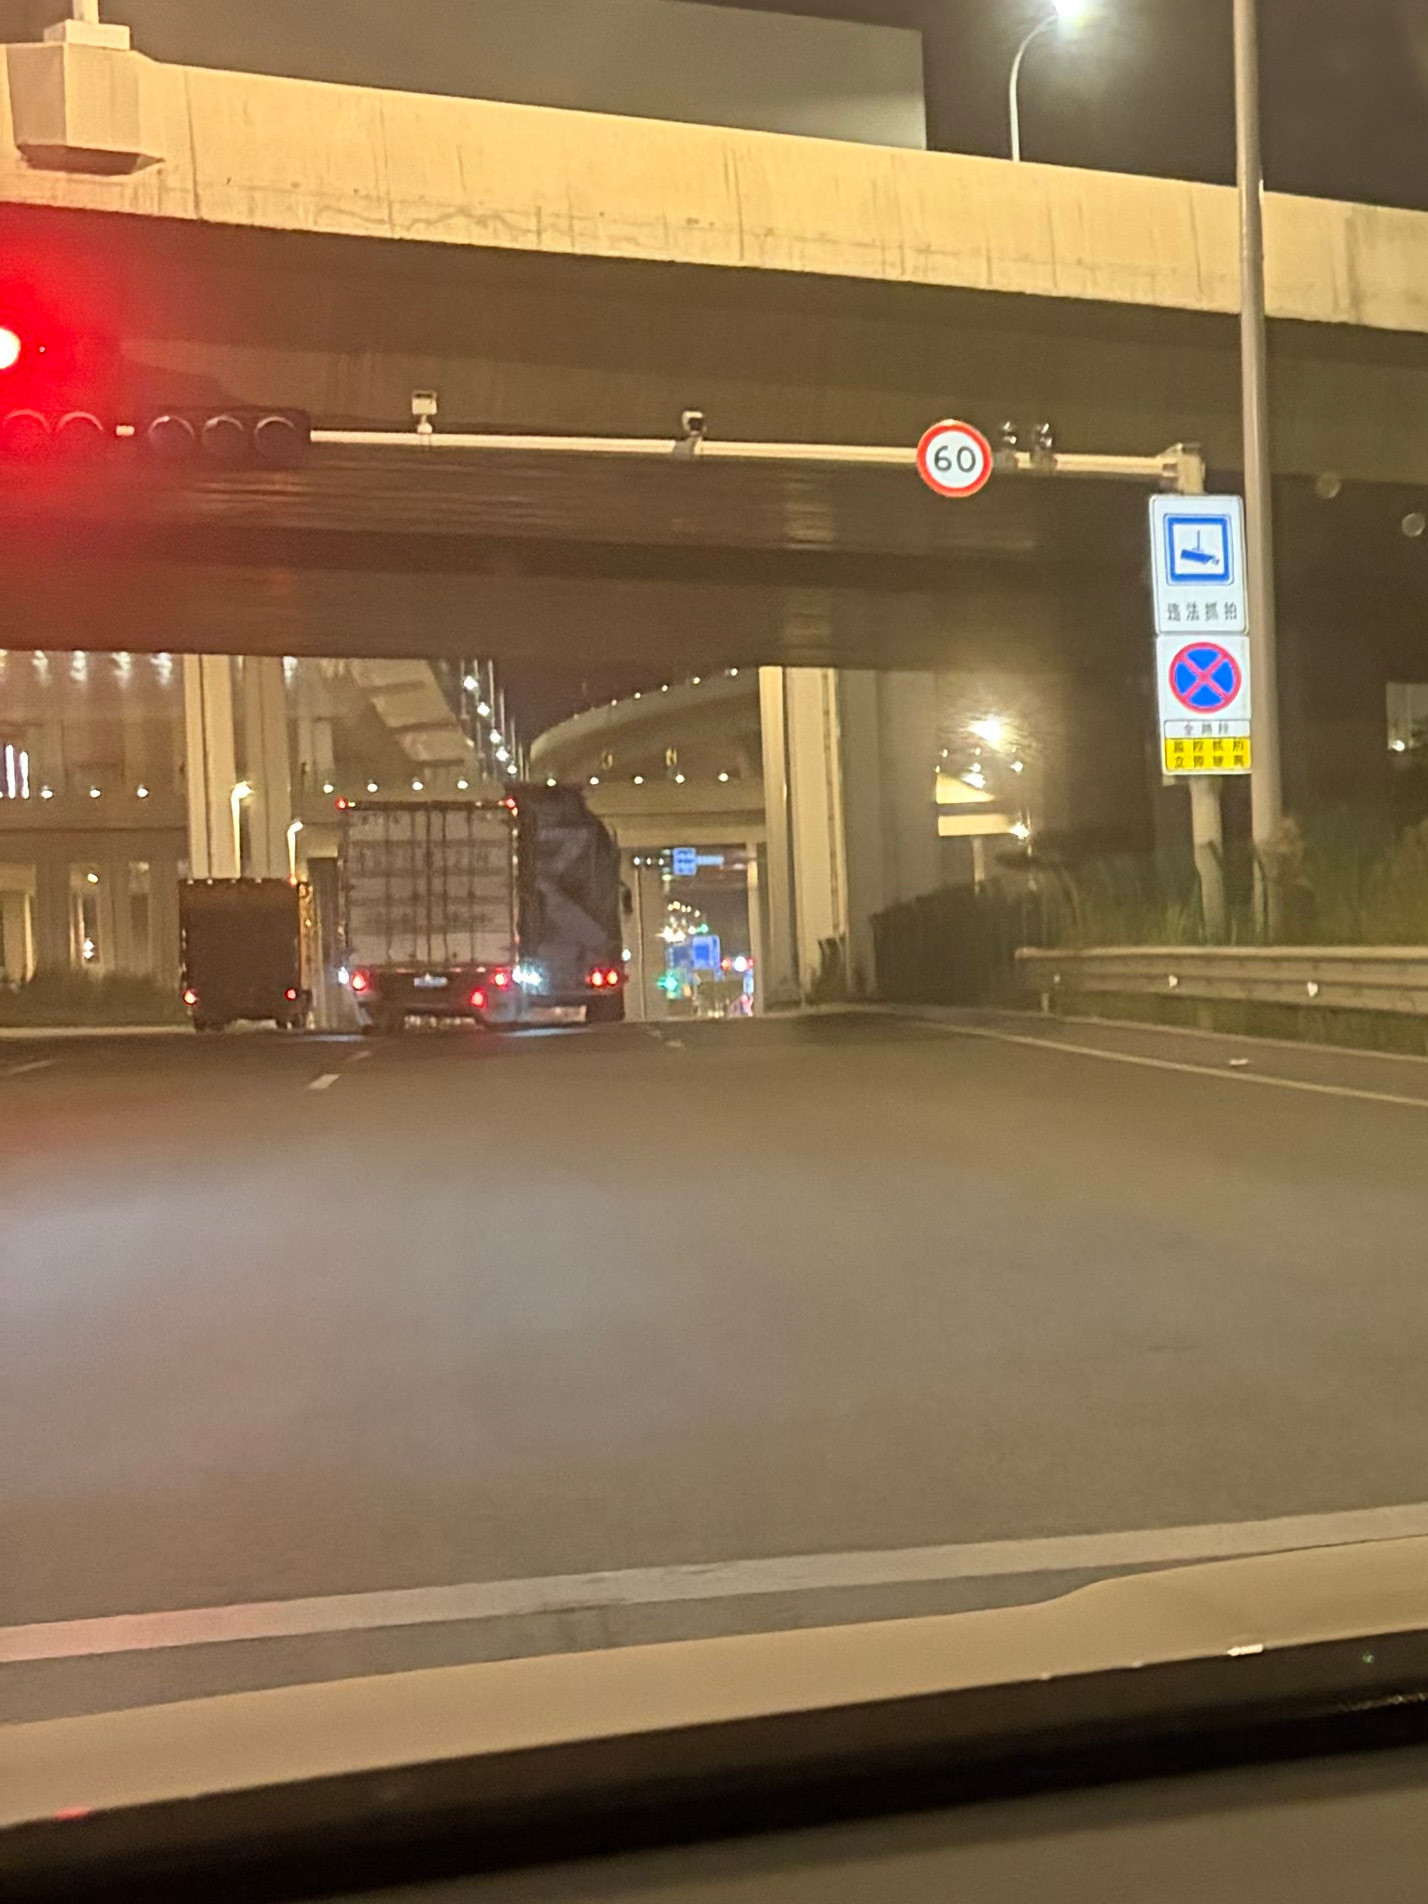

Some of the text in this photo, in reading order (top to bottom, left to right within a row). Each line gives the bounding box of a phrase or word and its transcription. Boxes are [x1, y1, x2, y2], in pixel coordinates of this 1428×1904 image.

[934, 445, 976, 473] 60
[1166, 601, 1239, 622] 违法抓拍
